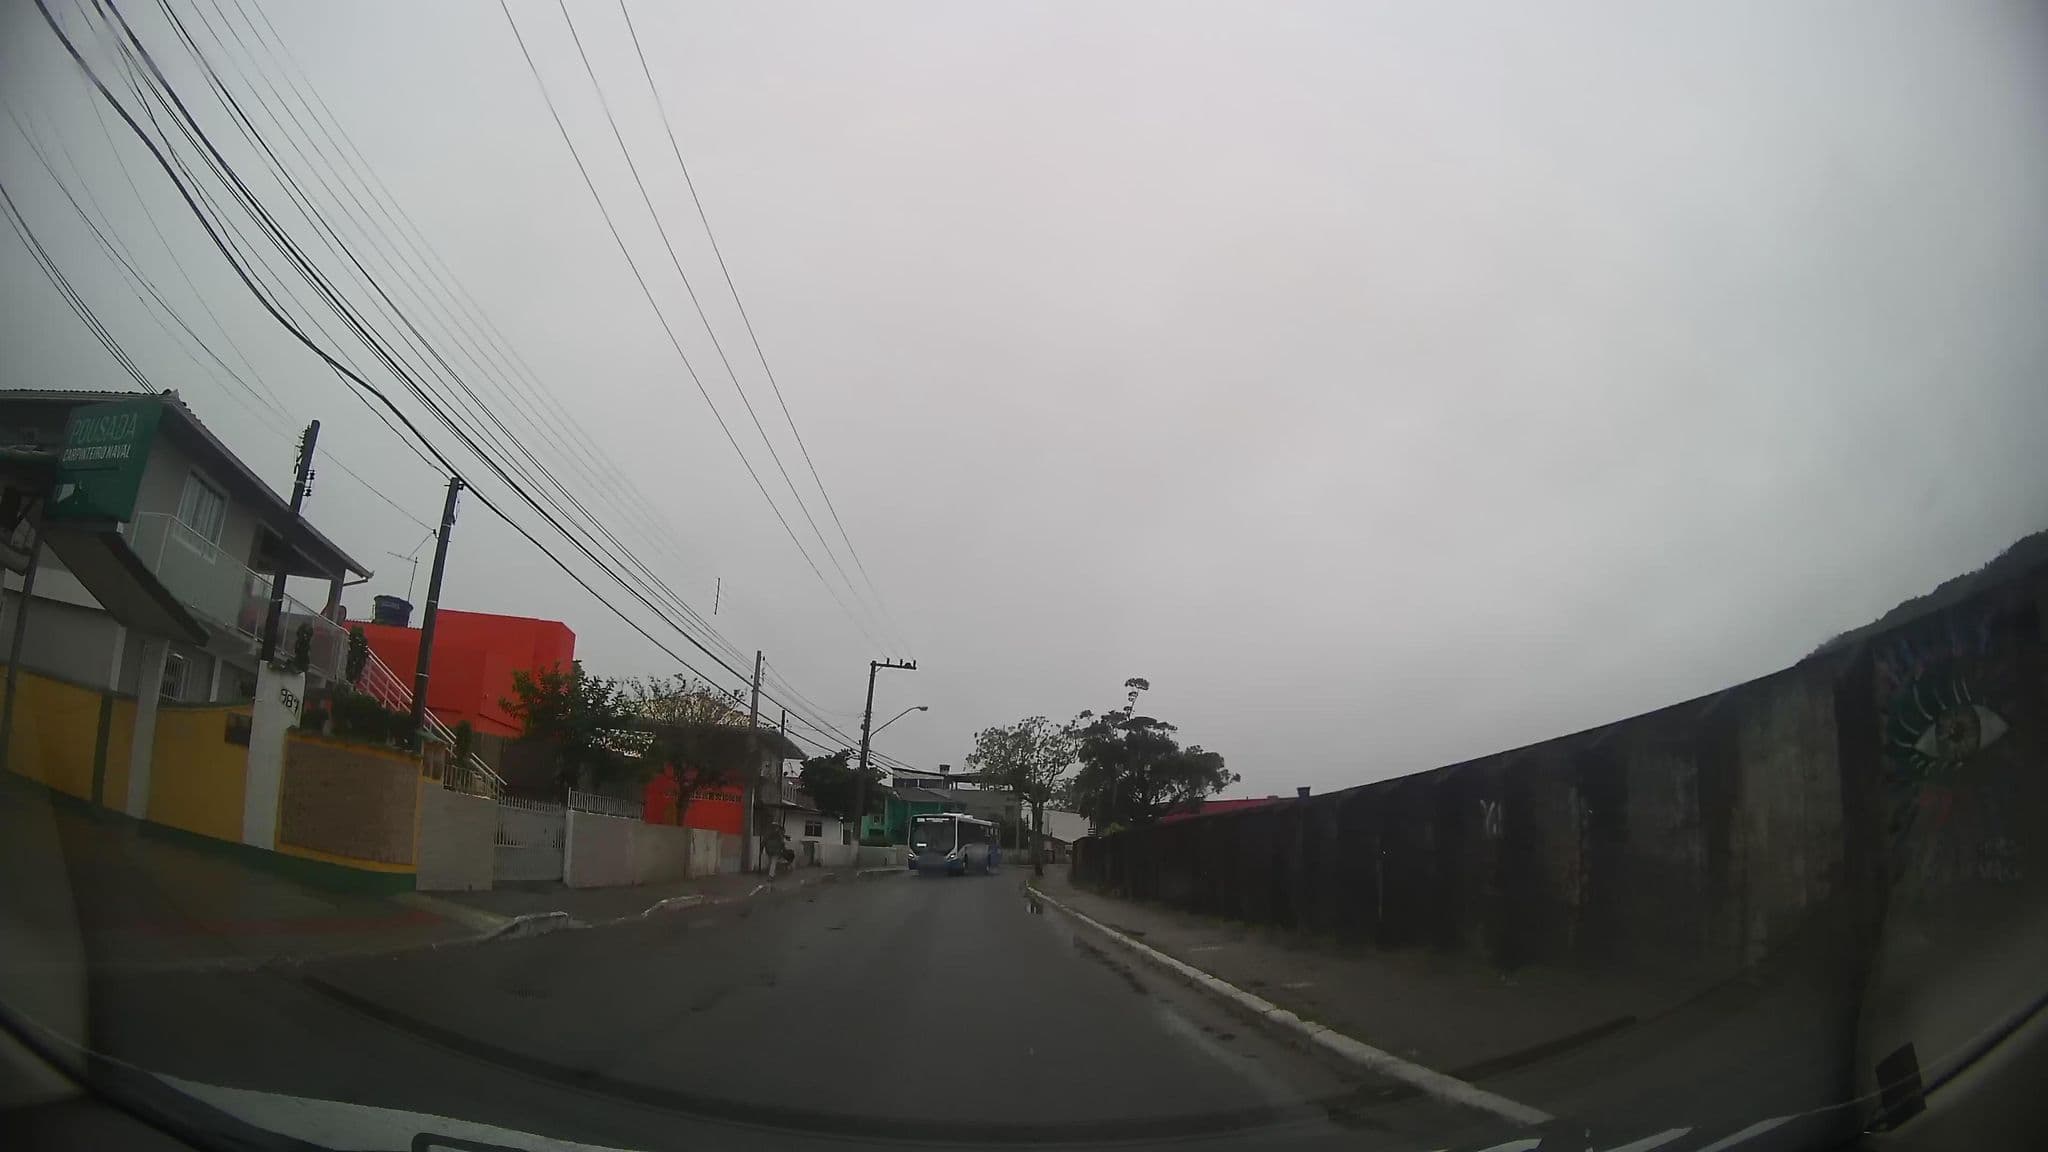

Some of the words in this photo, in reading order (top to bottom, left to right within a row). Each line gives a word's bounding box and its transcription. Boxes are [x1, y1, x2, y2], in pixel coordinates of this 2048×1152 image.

[69, 412, 138, 445] POUSADA
[62, 445, 107, 462] CARPINTEIRO
[106, 443, 131, 460] NAVAL
